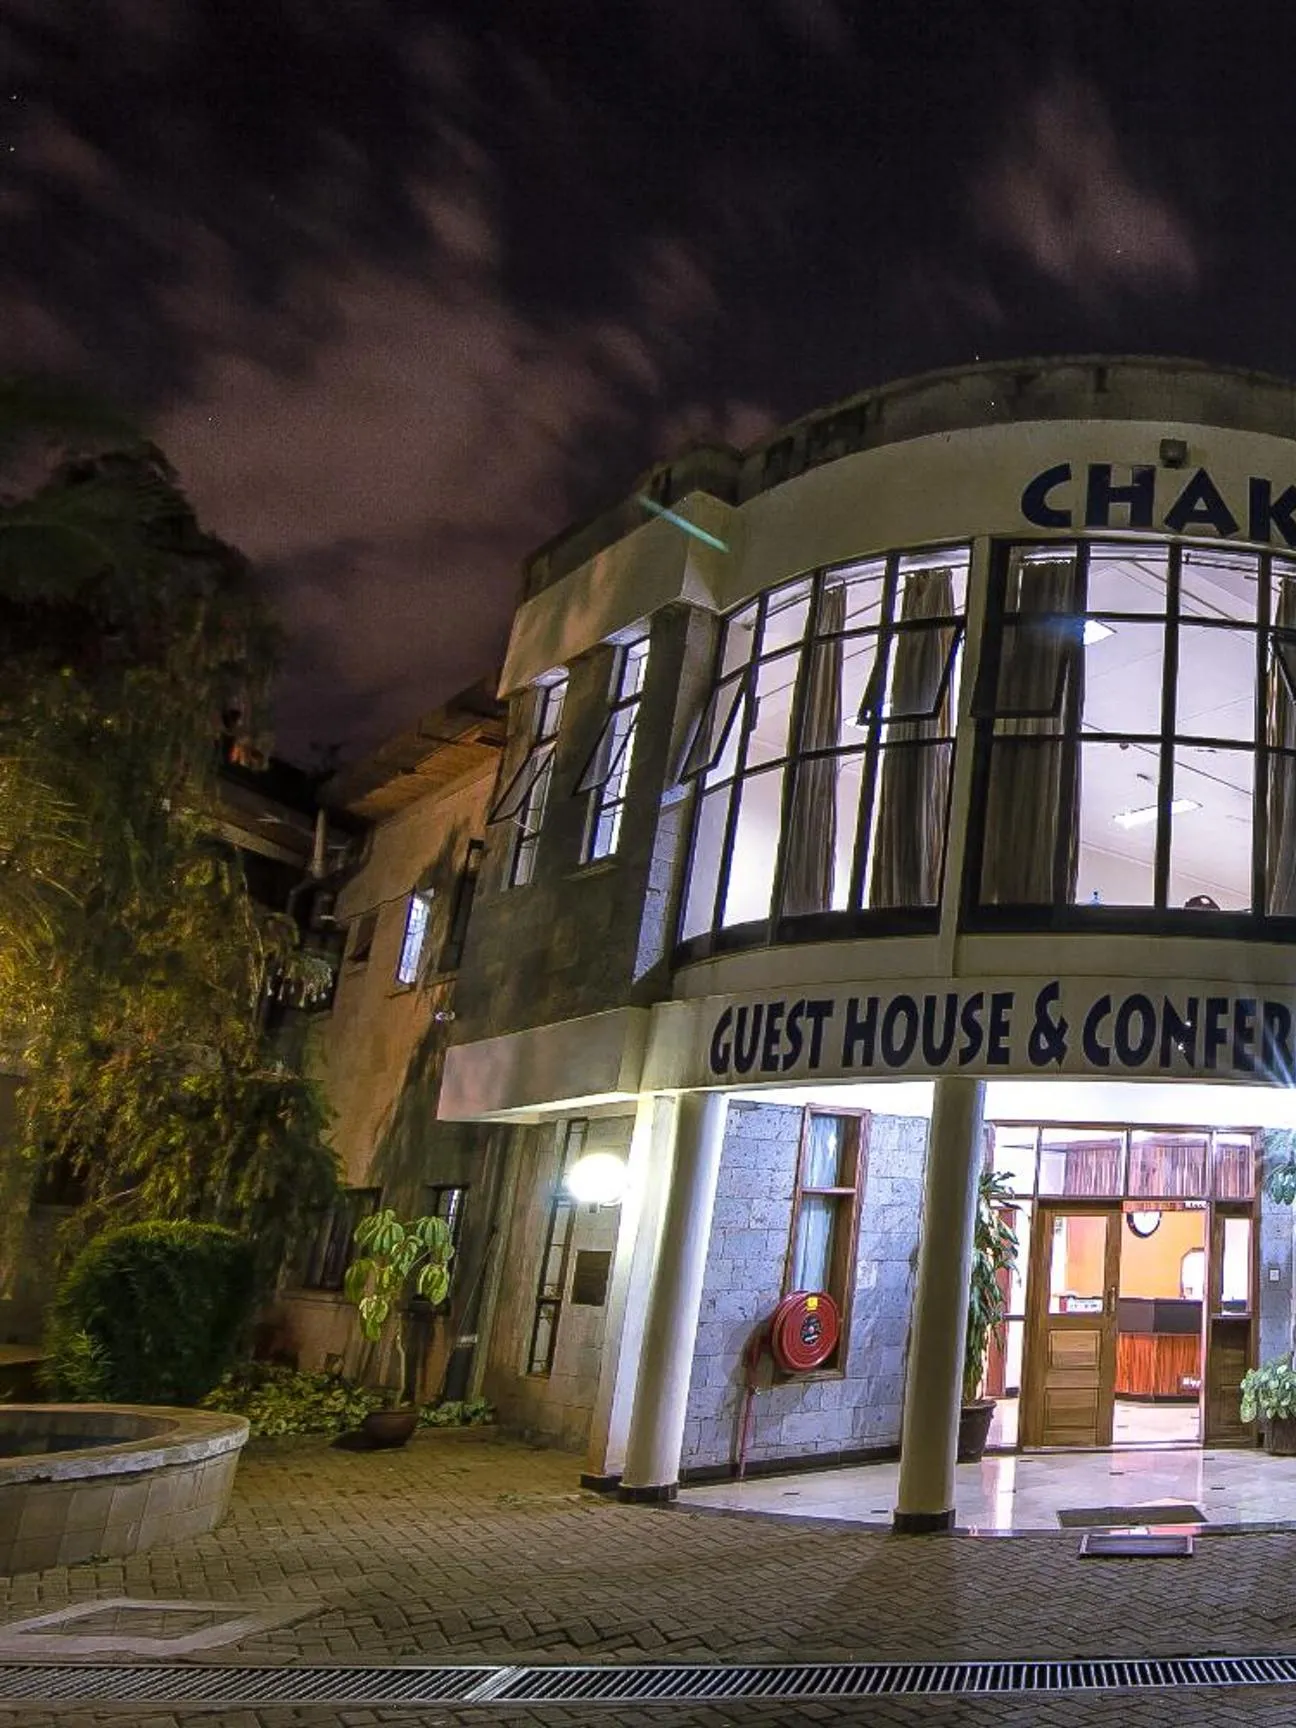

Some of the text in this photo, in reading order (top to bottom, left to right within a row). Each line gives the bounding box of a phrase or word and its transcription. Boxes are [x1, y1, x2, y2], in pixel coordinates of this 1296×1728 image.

[710, 999, 834, 1075] GUEST
[841, 992, 1015, 1068] HOUSE
[1028, 980, 1069, 1067] &
